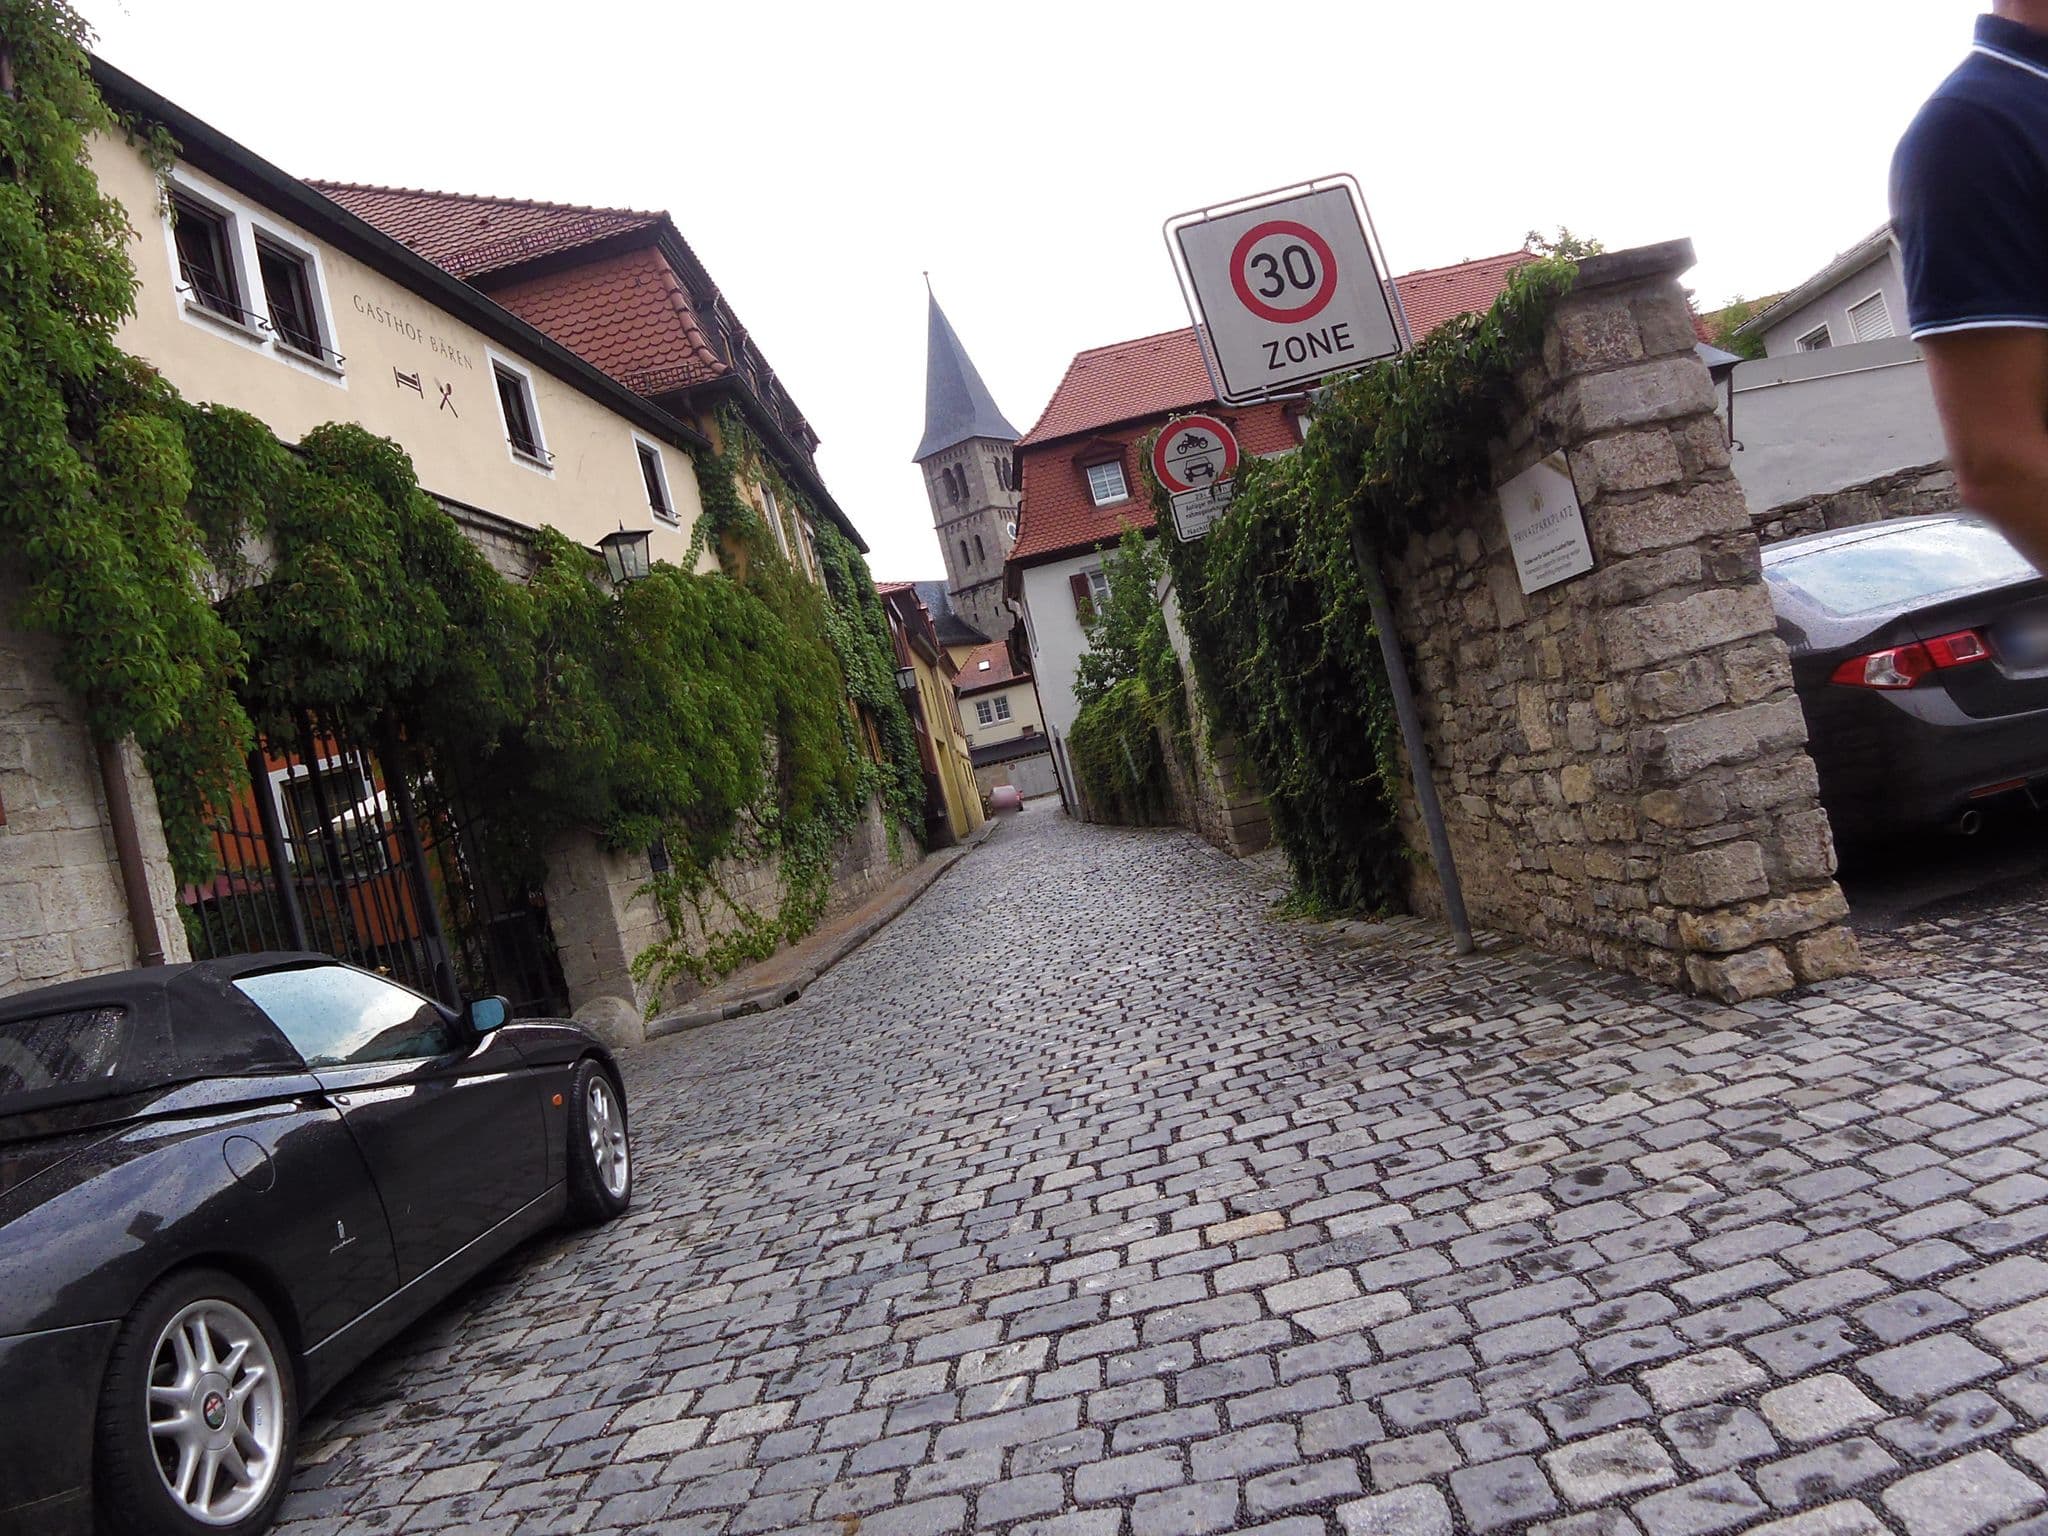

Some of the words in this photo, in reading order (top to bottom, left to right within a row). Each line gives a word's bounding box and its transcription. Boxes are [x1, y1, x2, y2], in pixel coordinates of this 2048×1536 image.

[1250, 244, 1316, 298] 30
[353, 294, 424, 344] GASTHOF
[430, 336, 473, 370] BÄREN
[1262, 322, 1355, 370] ZONE
[1513, 505, 1573, 542] PRIVATPARKPLATZ
